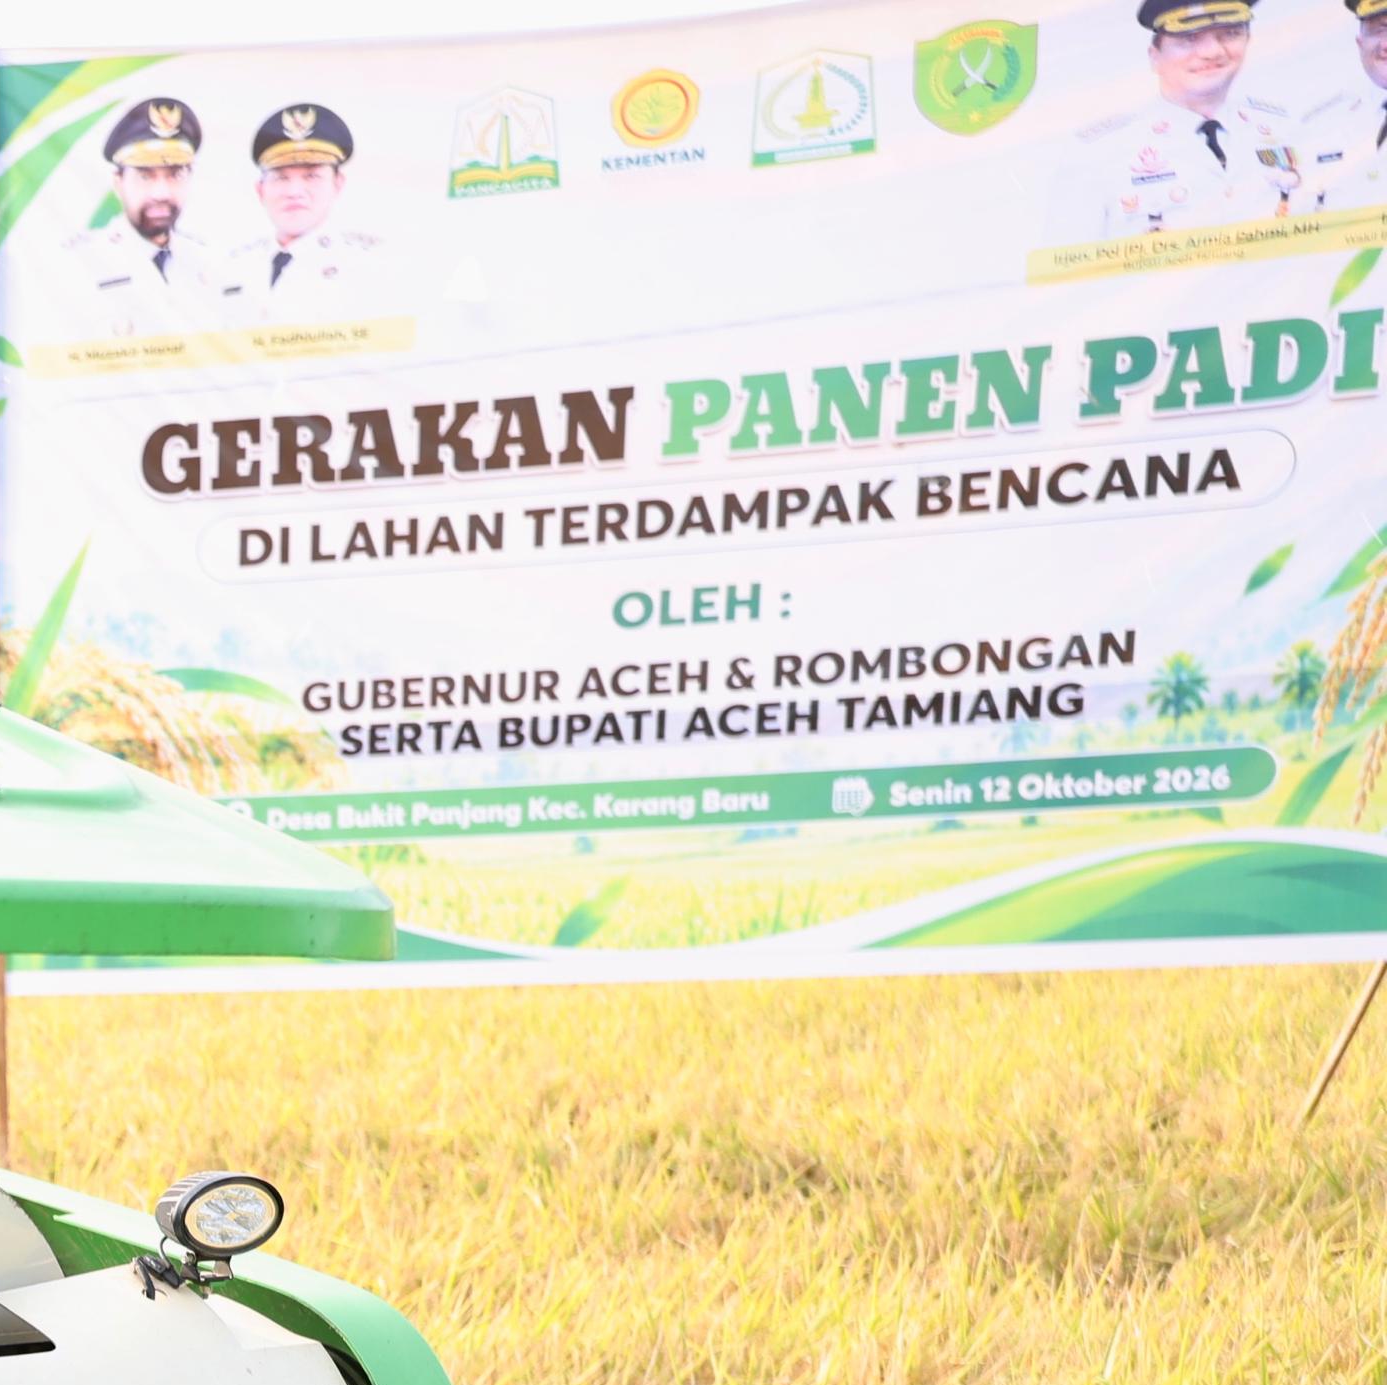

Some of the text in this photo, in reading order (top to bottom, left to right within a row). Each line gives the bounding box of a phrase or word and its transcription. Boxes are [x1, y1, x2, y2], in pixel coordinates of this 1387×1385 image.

[601, 147, 706, 172] KEMENTAN
[141, 308, 1385, 495] GERAKAN PANEN PADI
[238, 447, 1242, 567] DI LAHAN TERDAMPAK BENCANA
[612, 583, 761, 629] OLEH
[302, 630, 1136, 714] GUBERNUR ACEH & ROMBONGAN
[341, 683, 1085, 757] SERTA BUPATI ACEH TAMIANG
[267, 787, 769, 832] Desa Bukit Panjang Kec. Karang Baru
[889, 764, 1231, 806] Senin 12 Oktober 2026
